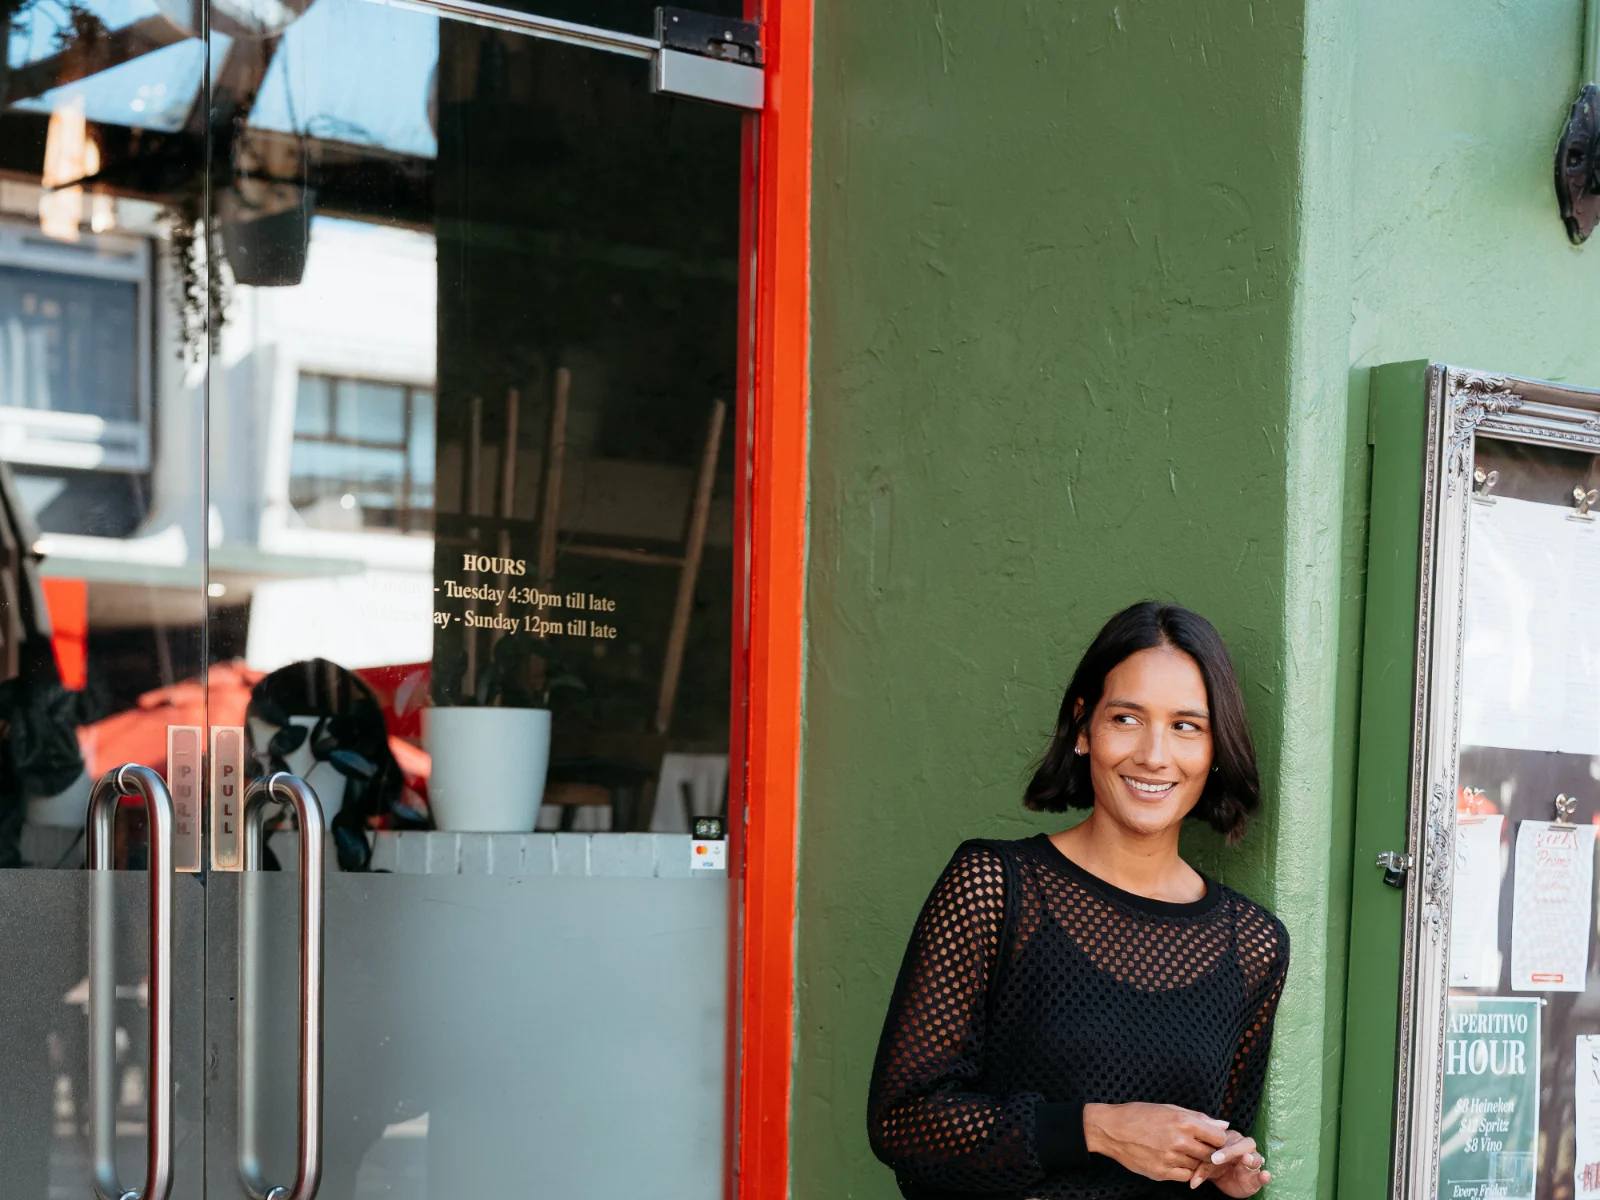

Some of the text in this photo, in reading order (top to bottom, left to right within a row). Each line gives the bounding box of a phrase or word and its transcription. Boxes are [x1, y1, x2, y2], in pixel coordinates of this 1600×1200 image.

[463, 553, 527, 576] HOURS
[444, 580, 505, 606] Tuesday
[508, 586, 562, 610] 4:30pm
[566, 593, 585, 610] till
[589, 594, 616, 612] late
[464, 610, 520, 635] Sunday
[523, 615, 563, 637] 12pm
[567, 619, 586, 637] till
[590, 620, 617, 639] late
[223, 765, 233, 834] PULL
[1446, 1013, 1528, 1034] APERITIVO
[1445, 1038, 1527, 1076] HOUR
[1471, 1096, 1515, 1113] Heineken
[1479, 1118, 1510, 1137] Spritz
[1464, 1137, 1503, 1154] $8 Vino
[1453, 1183, 1508, 1199] Every Friday
